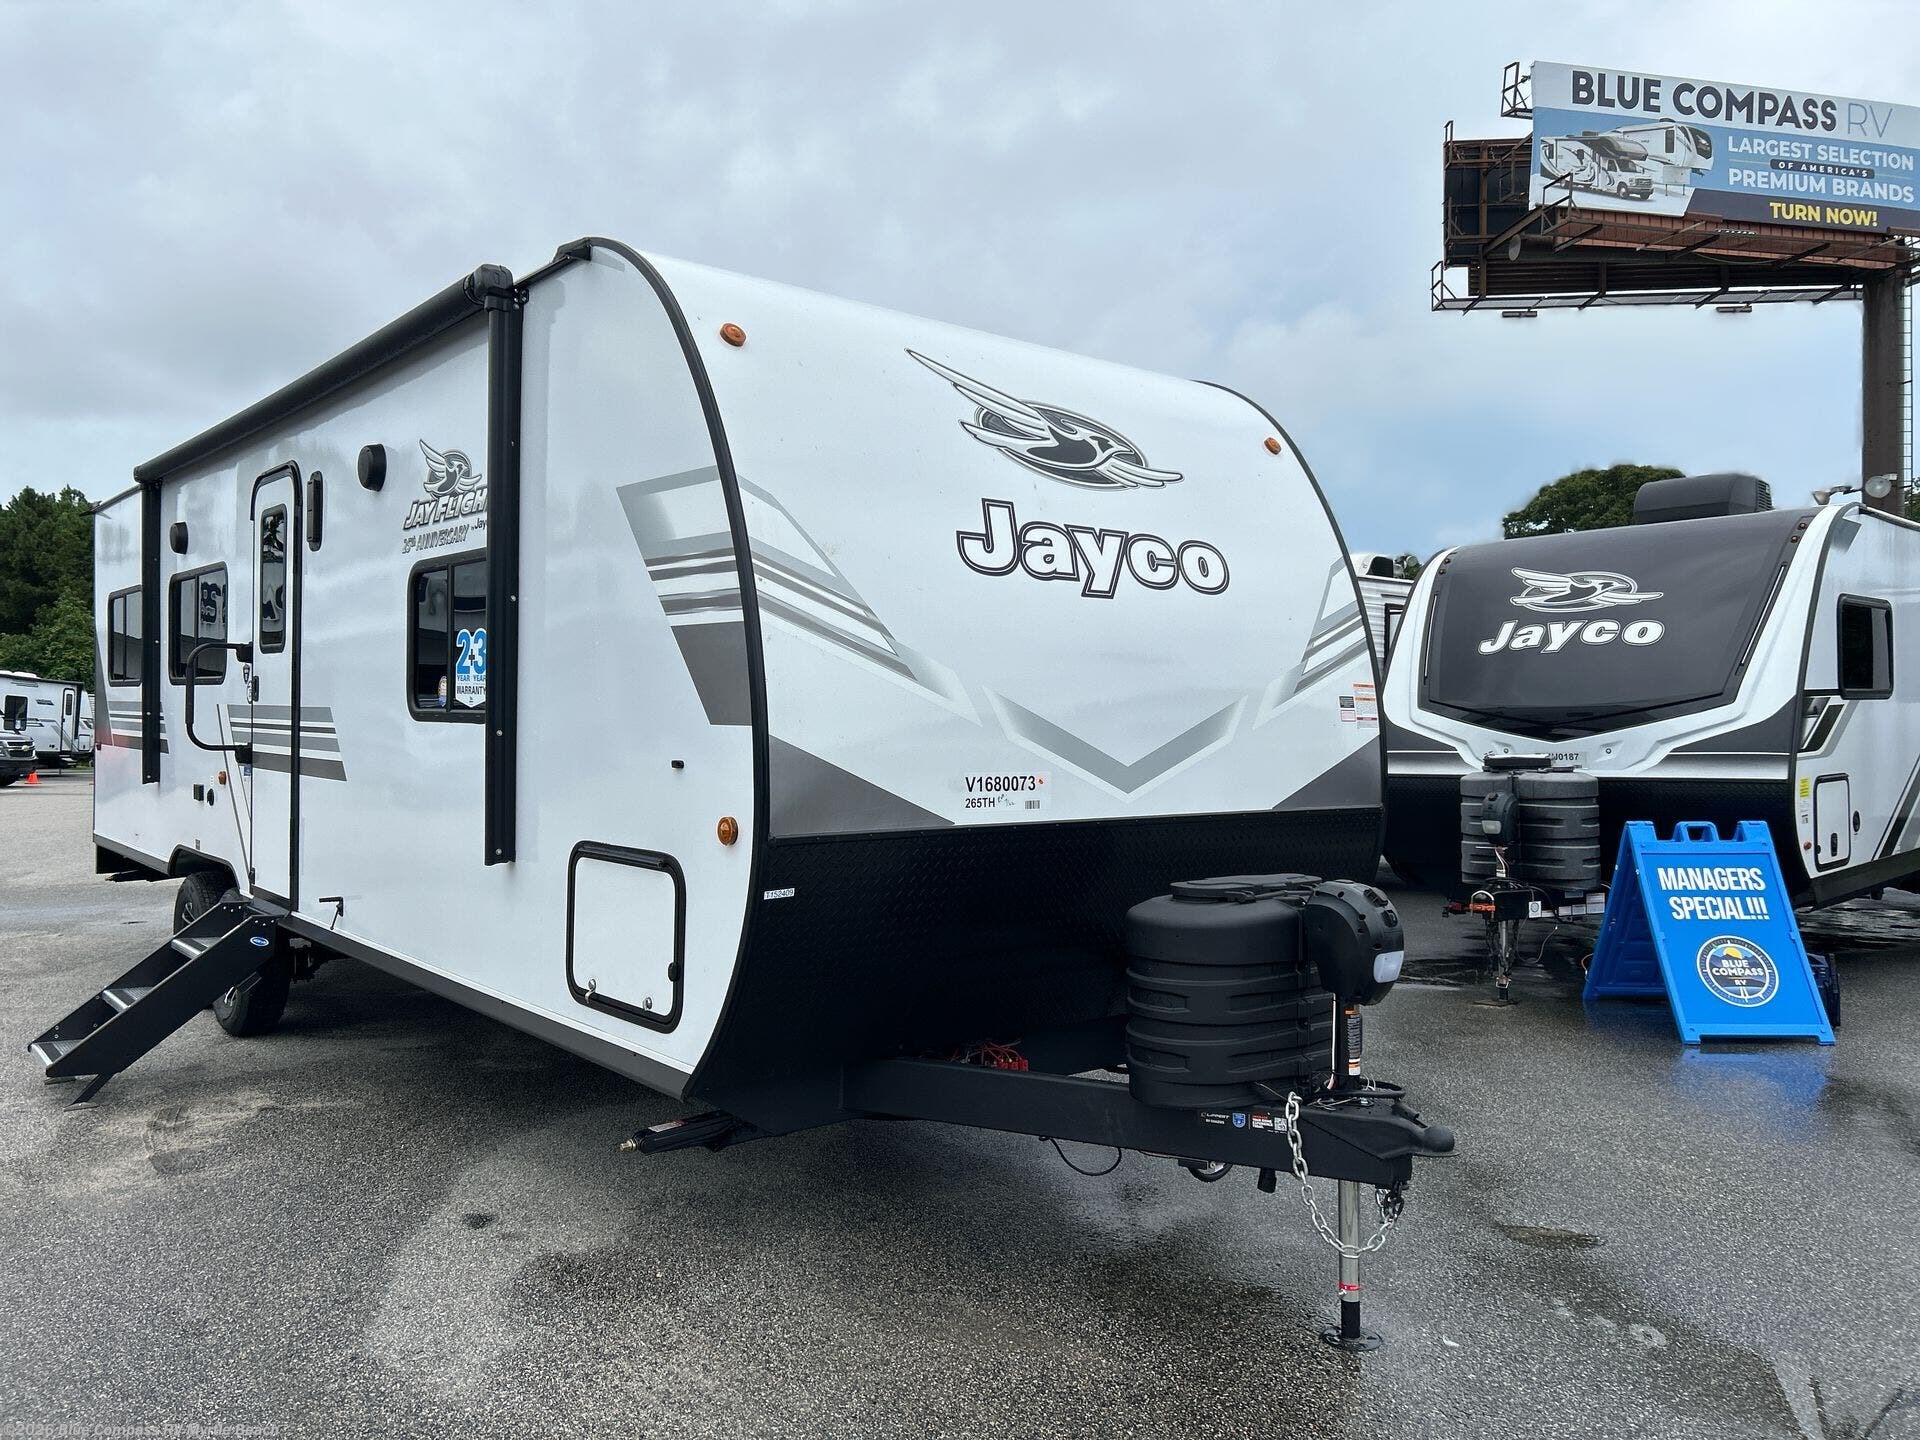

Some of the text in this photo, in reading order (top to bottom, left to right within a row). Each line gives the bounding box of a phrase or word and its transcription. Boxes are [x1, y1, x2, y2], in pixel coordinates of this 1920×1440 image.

[1572, 70, 1893, 138] BLUE COMPASS RV
[1728, 136, 1914, 171] LARGEST SELECTION
[1778, 161, 1868, 178] OF AMERICA'S
[1728, 168, 1915, 203] PREMIUM BRANDS
[1769, 202, 1878, 227] TURN NOW!
[403, 486, 487, 531] JAY FLIGH
[416, 523, 470, 551] ANNIVERSARY
[956, 497, 1230, 600] Jayco
[1477, 619, 1665, 655] Jayco
[457, 674, 471, 682] YEAR
[457, 685, 486, 695] WARRANTY
[965, 775, 1036, 793] V1680073
[965, 796, 996, 809] 265TH
[1657, 867, 1766, 891] MANAGERS
[1669, 896, 1770, 920] SPECIAL!!!
[1711, 967, 1765, 977] COMPASS
[1721, 959, 1750, 968] BLUE
